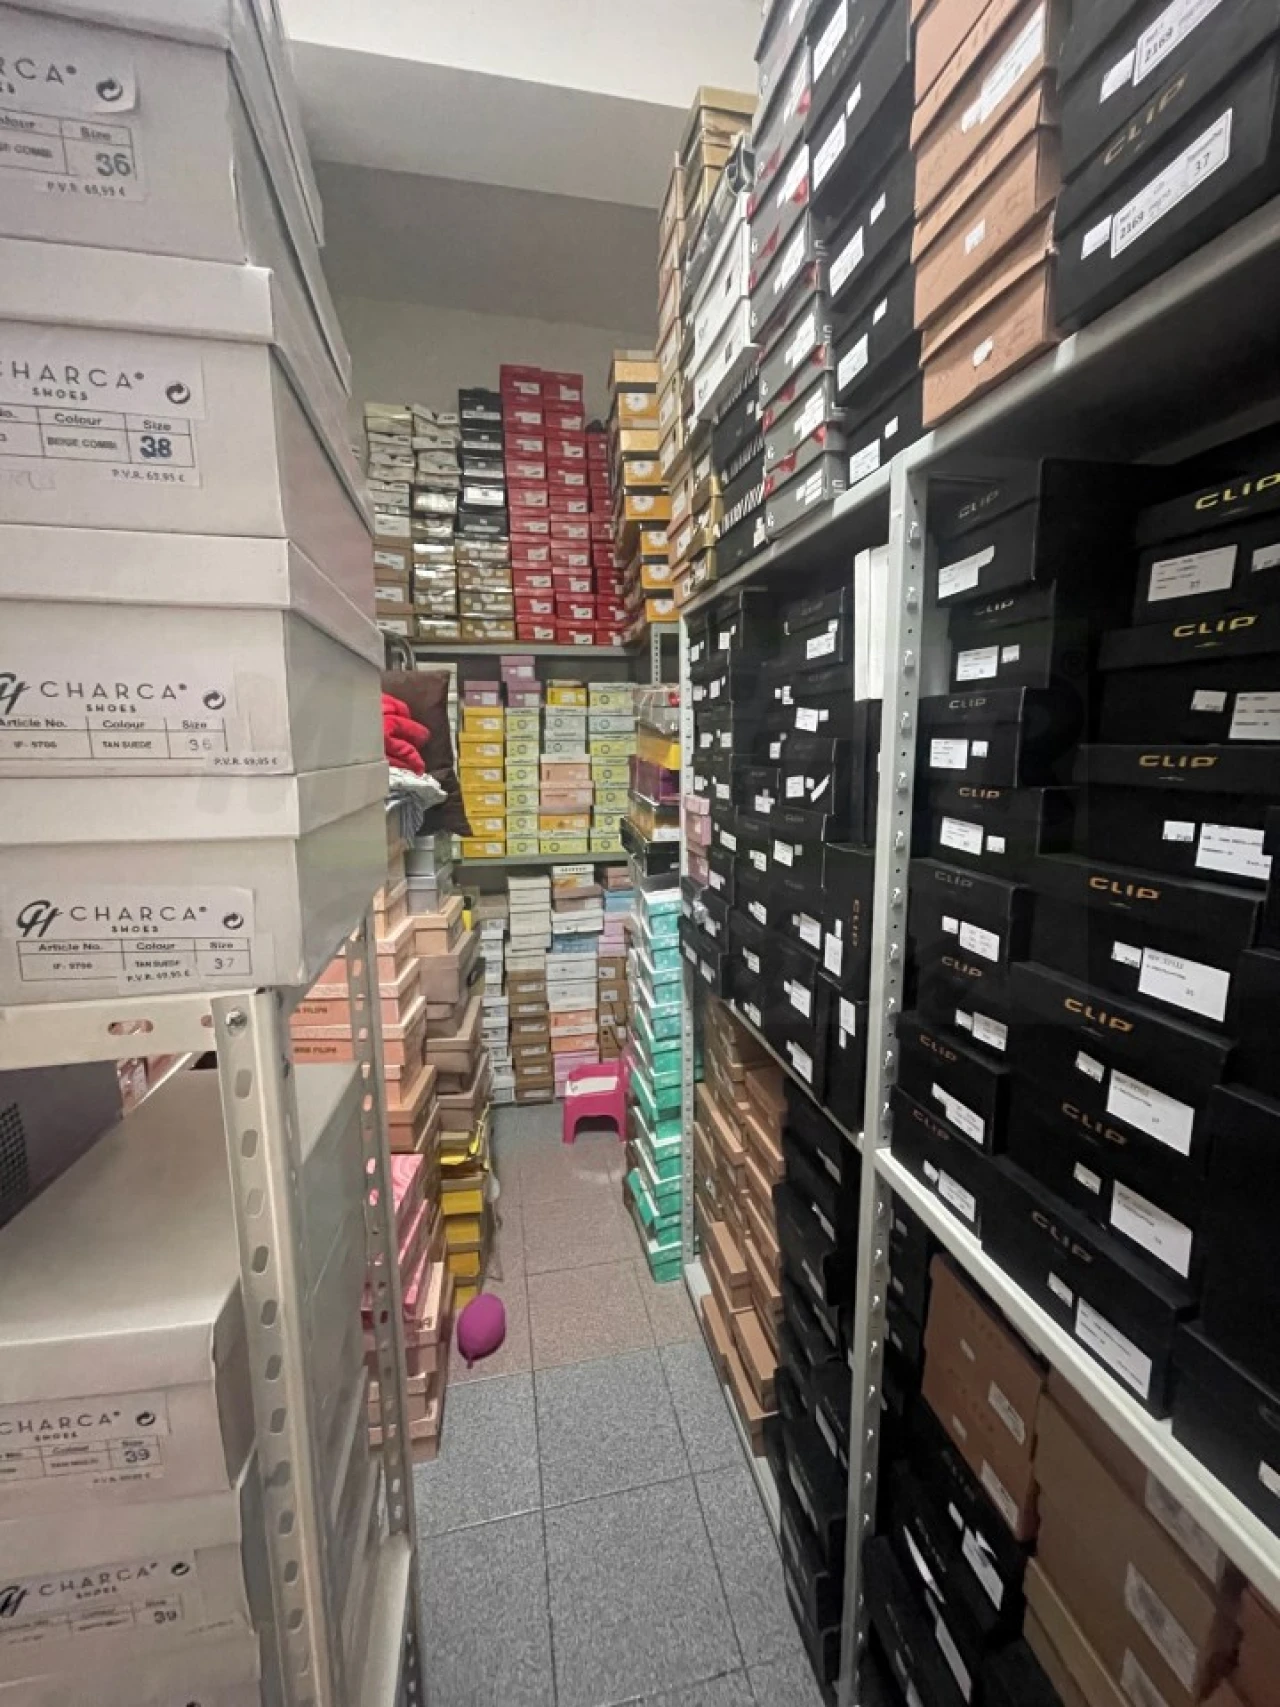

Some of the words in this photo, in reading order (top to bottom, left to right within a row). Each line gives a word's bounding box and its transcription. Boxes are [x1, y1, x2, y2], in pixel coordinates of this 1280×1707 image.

[1104, 73, 1188, 165] CLIP
[96, 153, 130, 176] 36
[0, 360, 132, 389] HARCA
[32, 387, 88, 400] SHOES
[54, 412, 102, 425] Colour
[143, 420, 171, 431] Size
[140, 435, 172, 458] 38
[1172, 614, 1258, 638] CLIP
[40, 681, 177, 700] CHARCA
[86, 704, 137, 712] SHOES
[949, 698, 986, 709] CLIP
[1139, 755, 1218, 769] CLIP
[959, 787, 1000, 800] CLIP
[1089, 876, 1162, 901] CLIP
[70, 906, 197, 921] CHARCA
[111, 925, 159, 933] SHOES
[213, 957, 235, 970] 37
[942, 956, 982, 977] CLIP
[1064, 998, 1135, 1033] CLIP
[1061, 1102, 1128, 1146] CLIP
[1031, 1209, 1094, 1264] CLIP
[124, 1448, 150, 1463] 39
